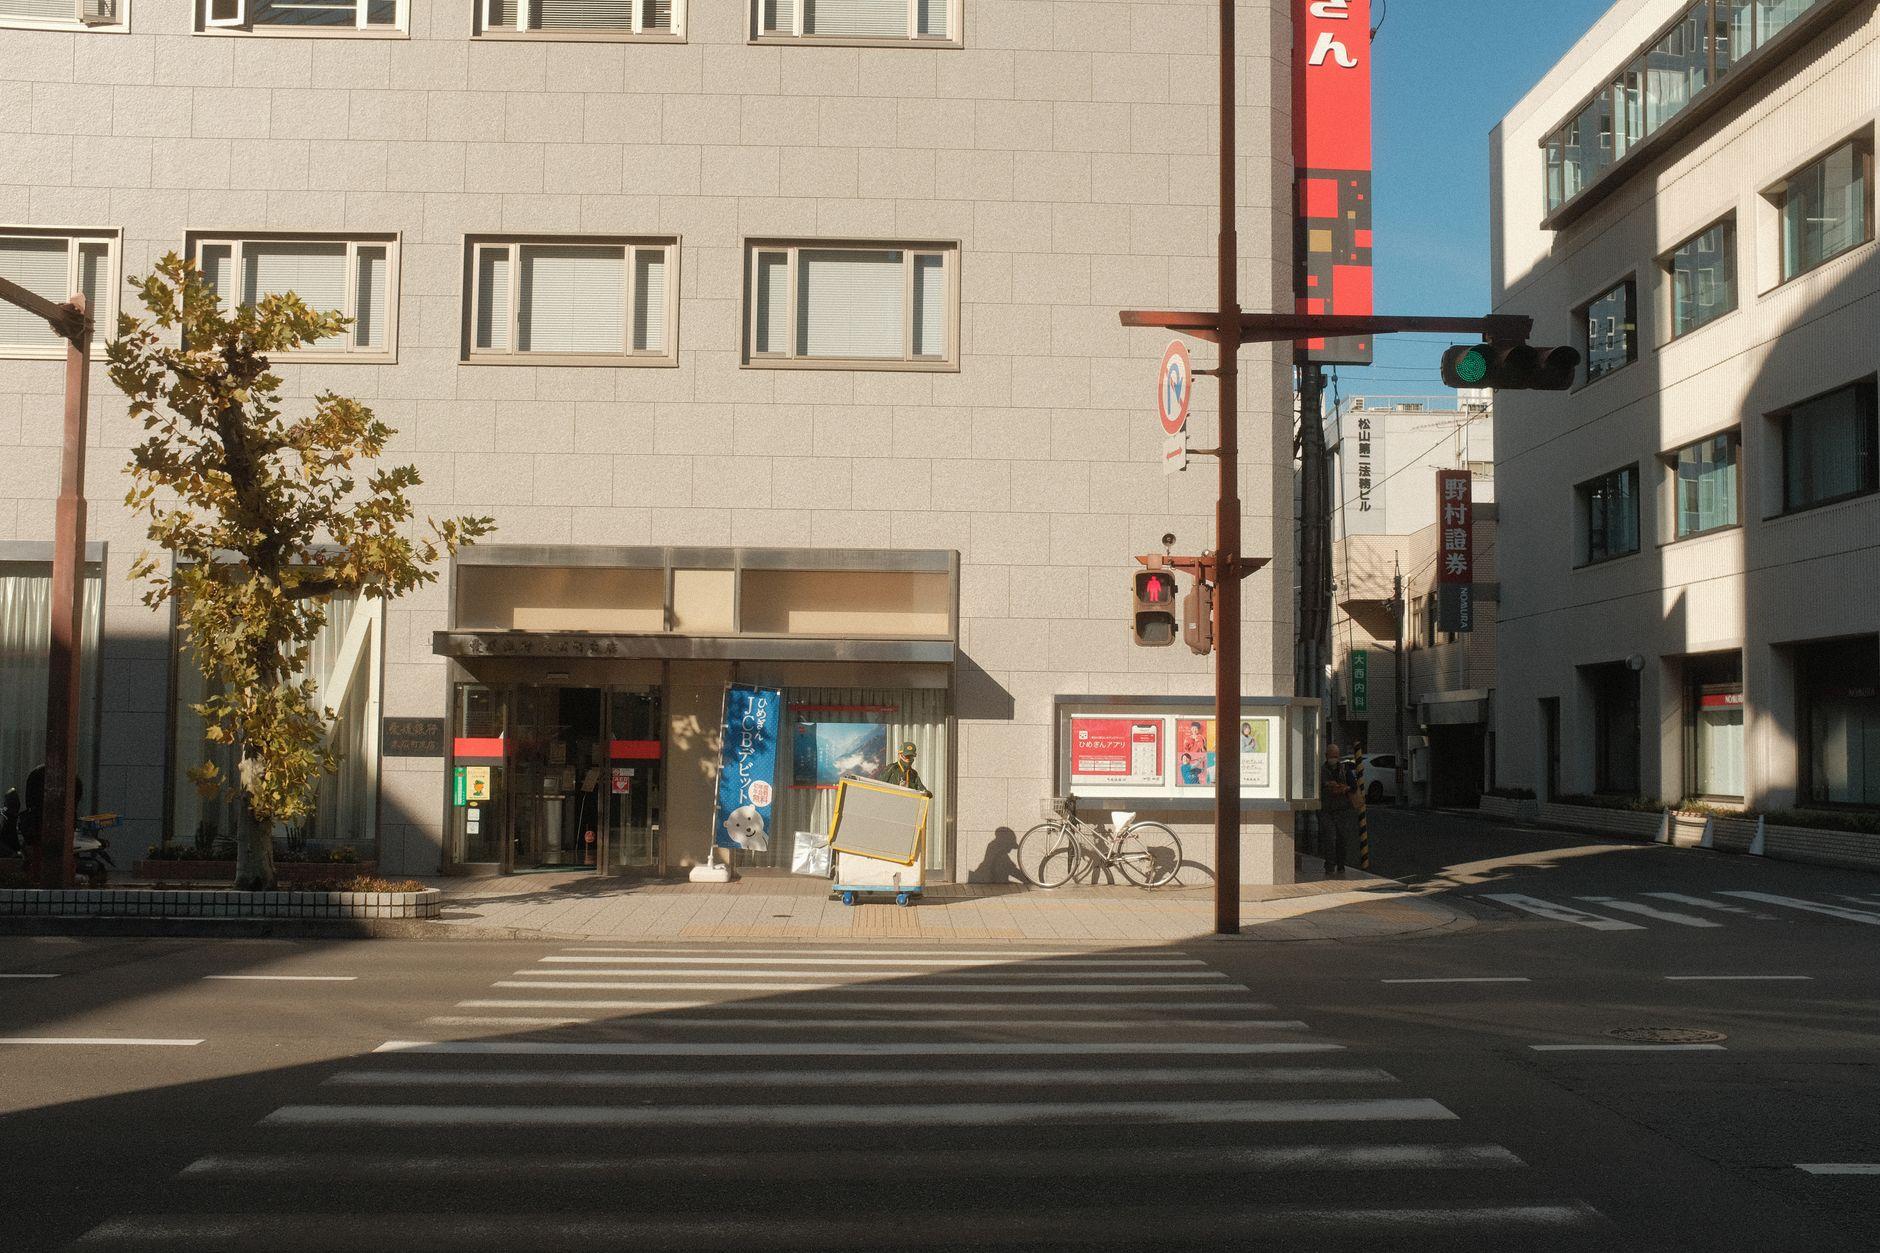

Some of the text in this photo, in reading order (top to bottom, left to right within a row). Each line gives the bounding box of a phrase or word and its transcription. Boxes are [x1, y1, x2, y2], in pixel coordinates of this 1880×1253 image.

[1358, 418, 1371, 512] 松山第二法務ビル
[1444, 478, 1468, 575] 野村證券
[1459, 587, 1469, 629] NOMURA
[1354, 654, 1365, 707] 大西内科
[754, 698, 768, 742] ひめぎん
[1078, 741, 1127, 749] ひめぎんアプリ
[738, 696, 756, 804] JCBデビット
